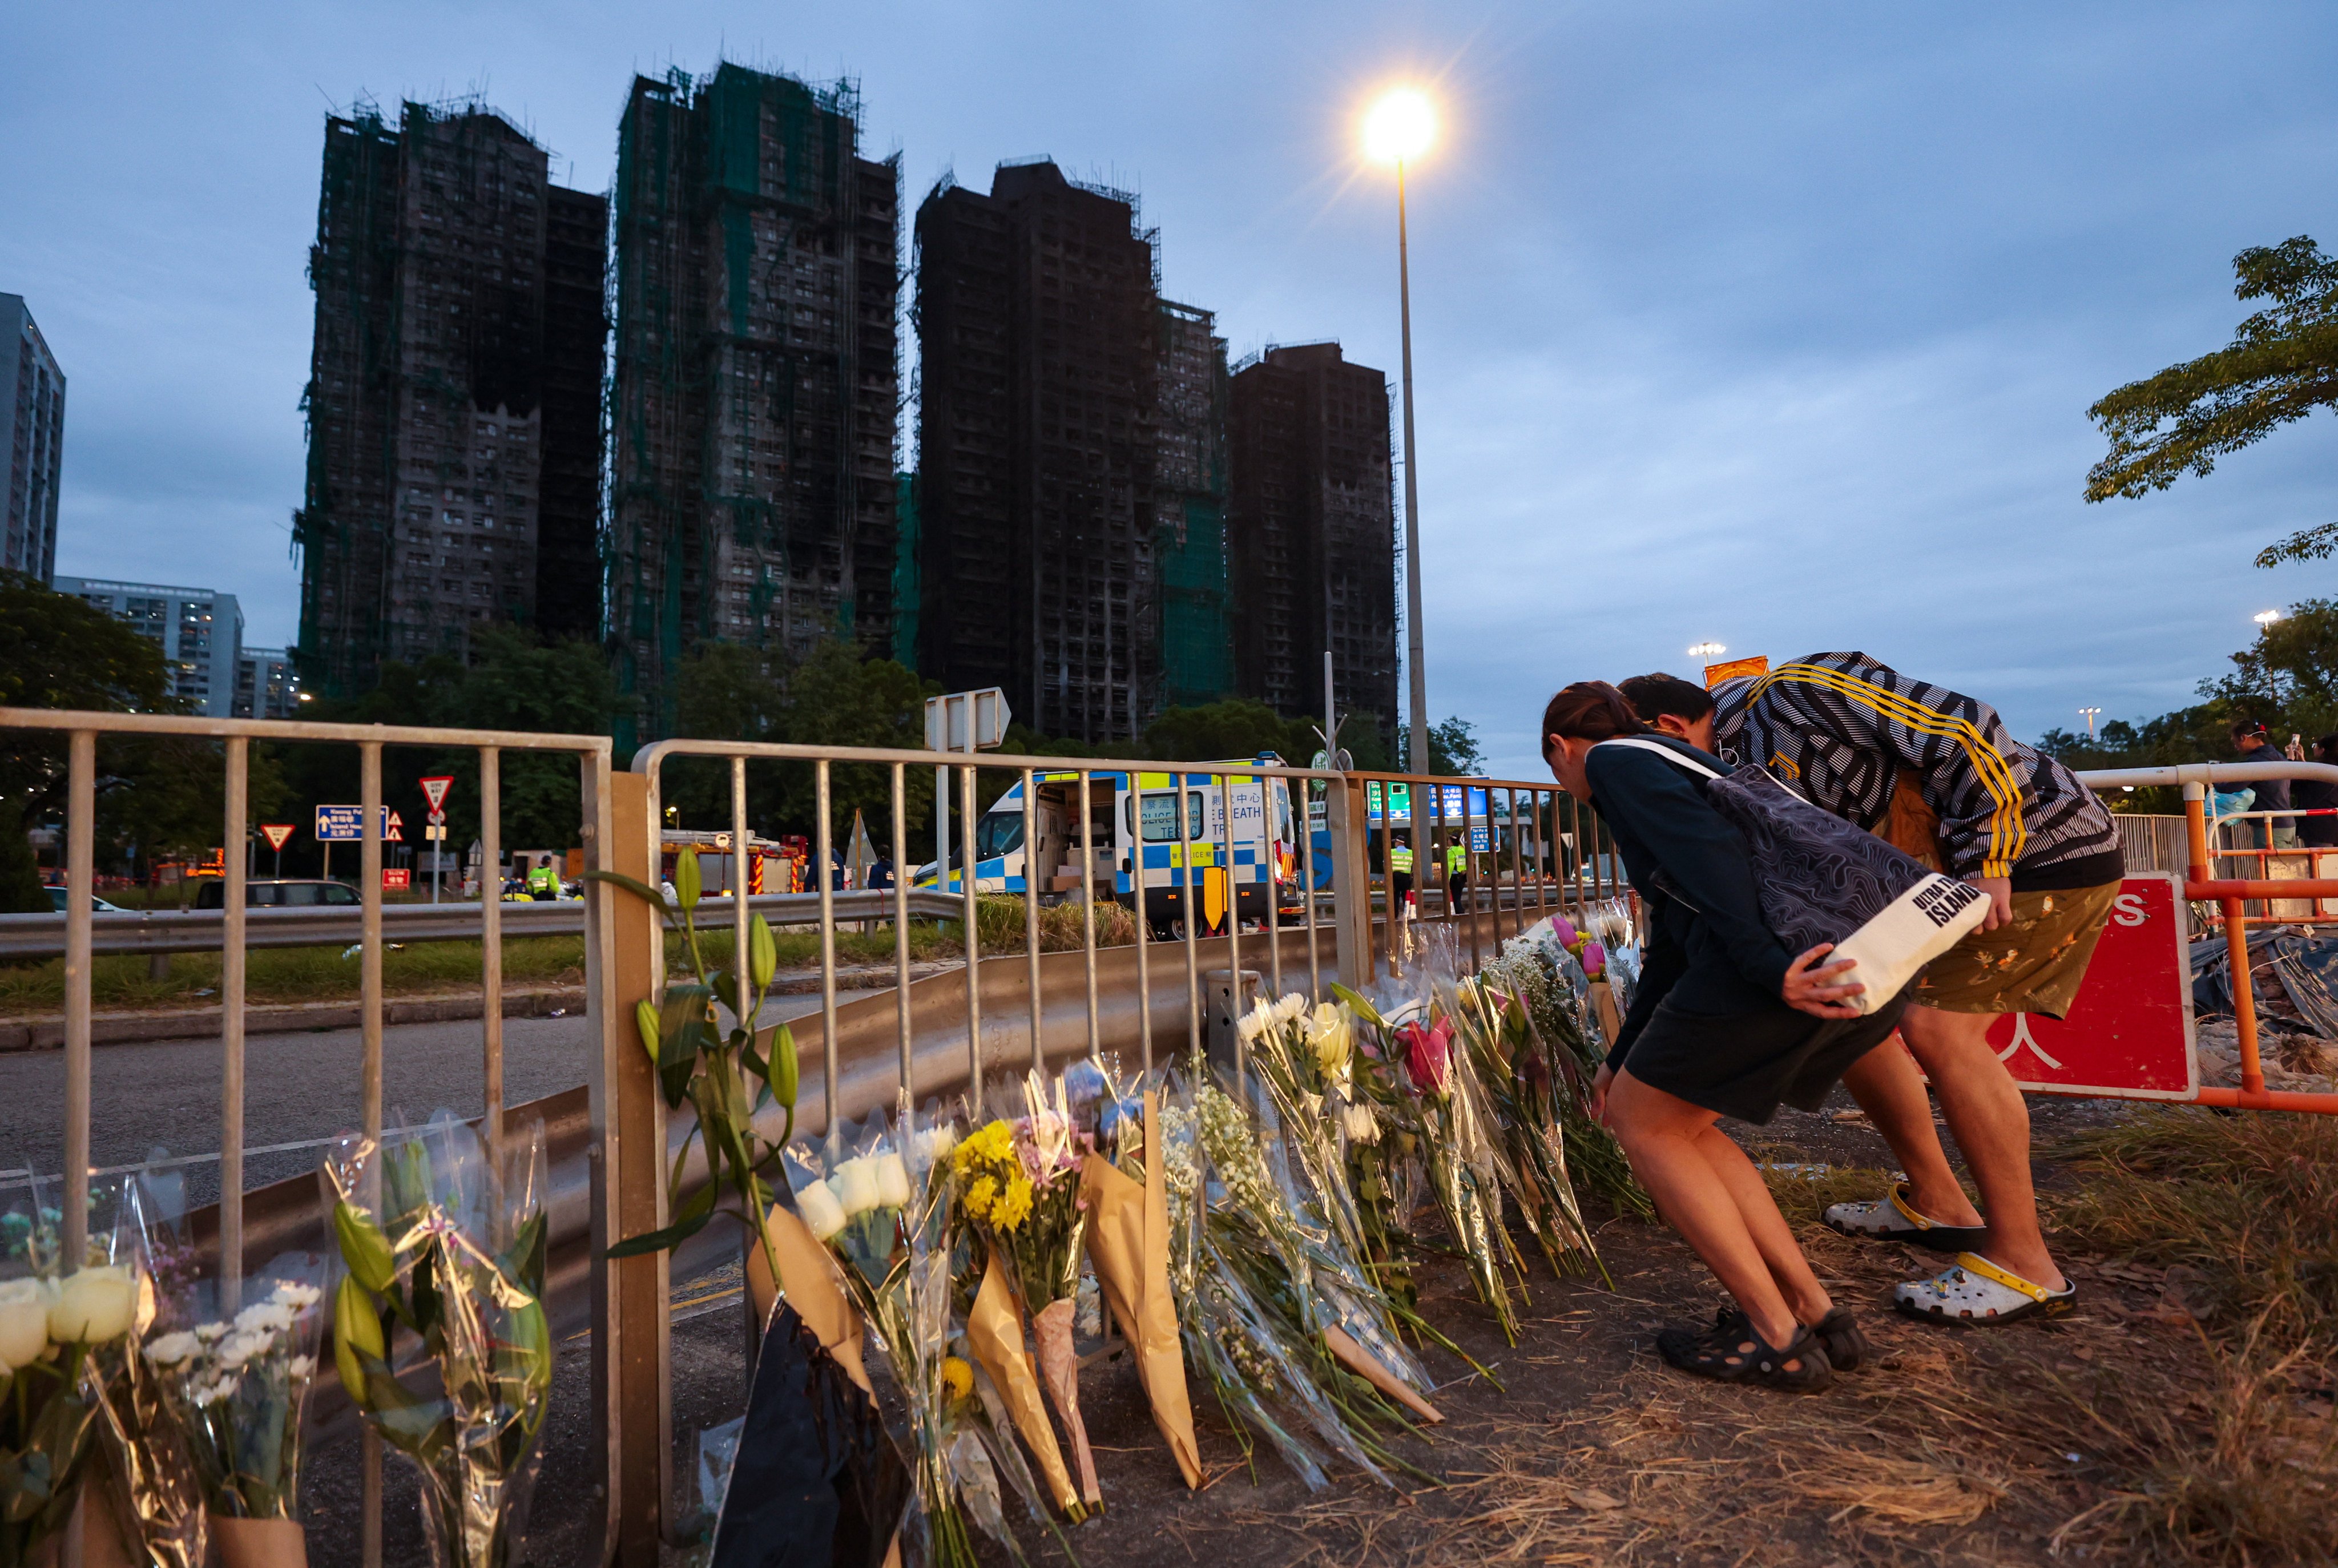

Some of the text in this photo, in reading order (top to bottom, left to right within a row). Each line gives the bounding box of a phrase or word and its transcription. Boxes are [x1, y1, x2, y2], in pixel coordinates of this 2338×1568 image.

[1142, 812, 1171, 824] OLICE
[1218, 807, 1261, 820] BEATH
[1912, 884, 1946, 910] ULTRA
[1925, 884, 1981, 928] ISLAND
